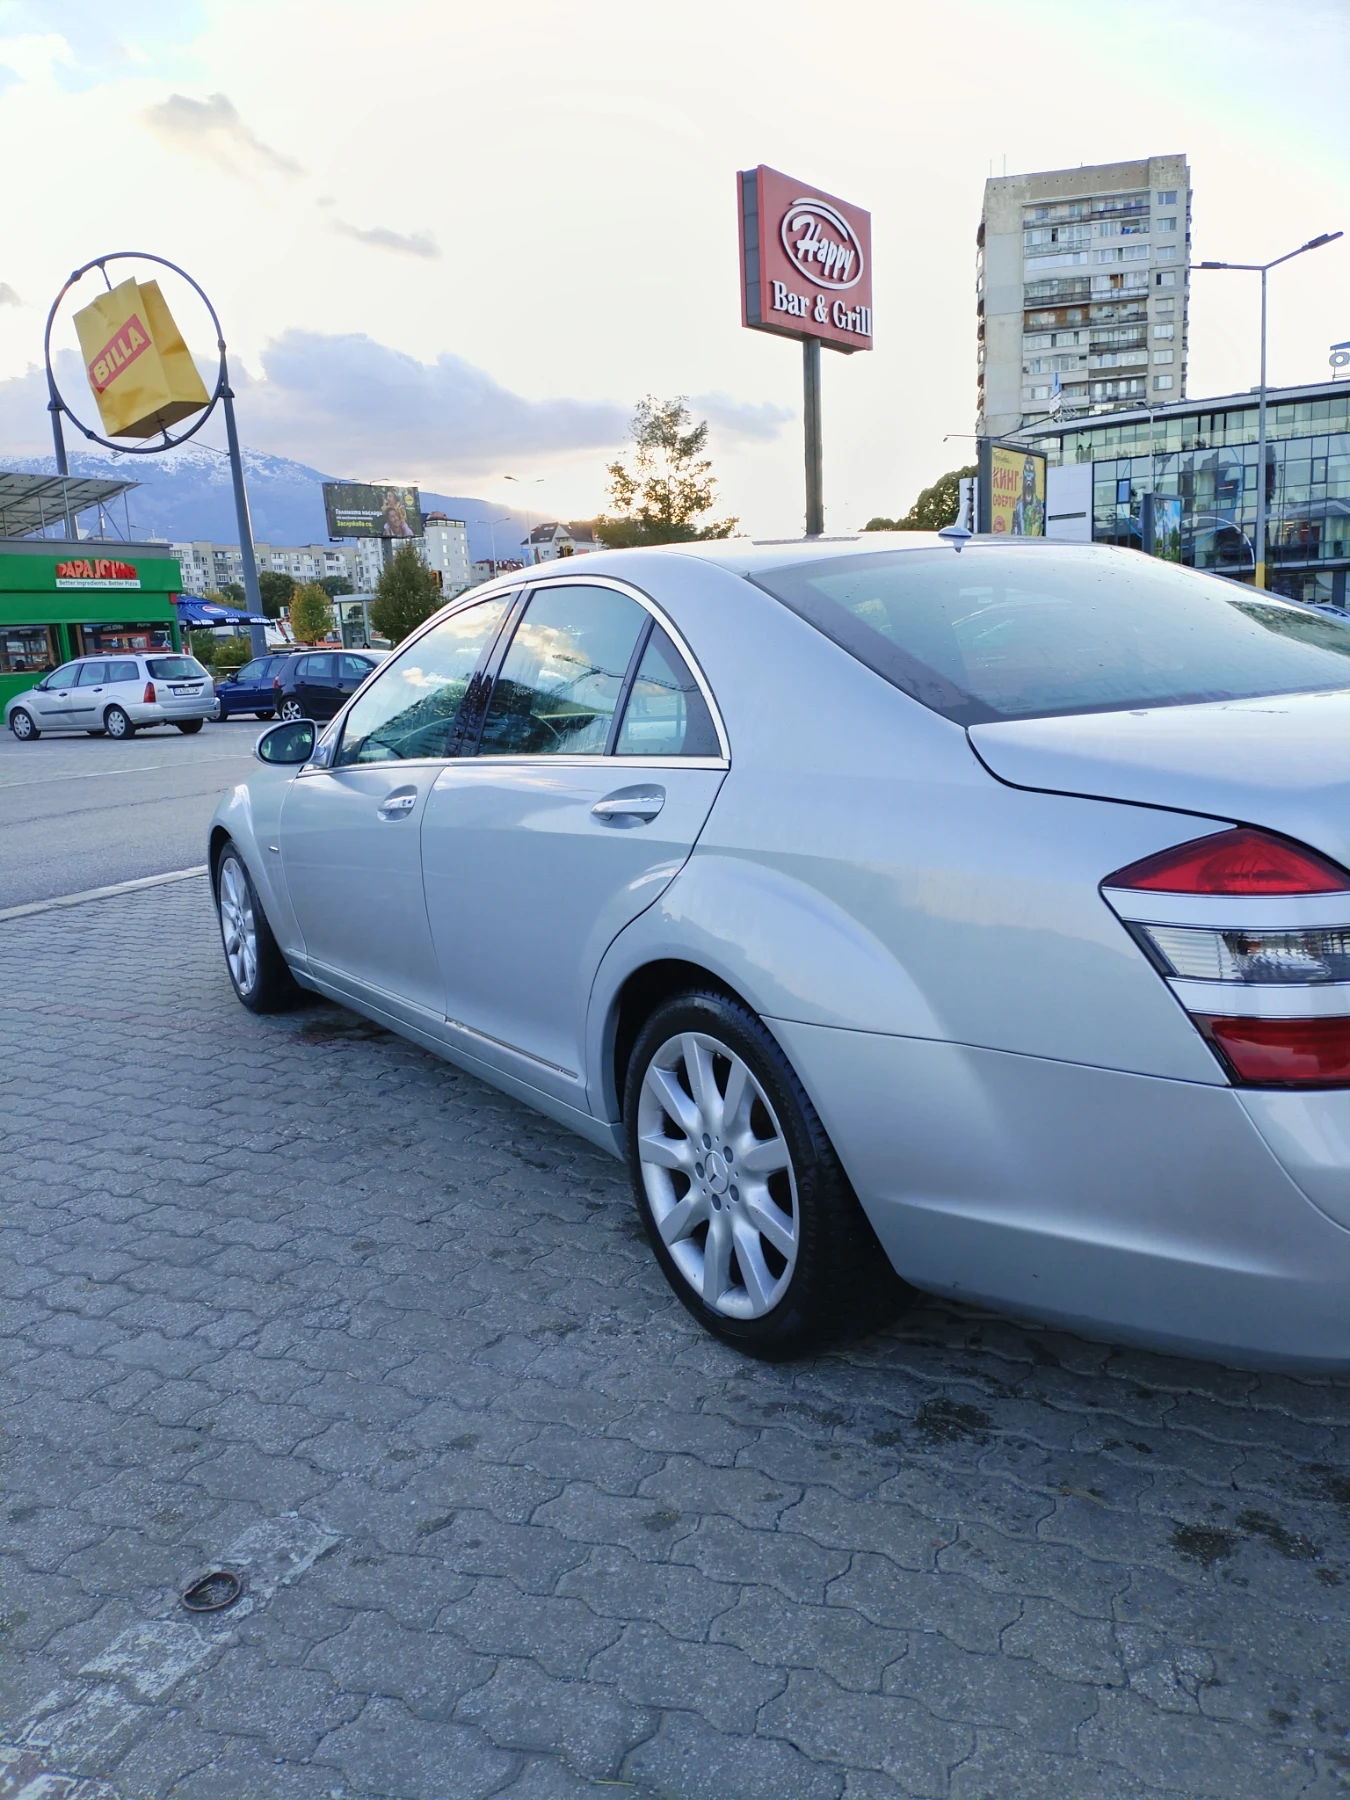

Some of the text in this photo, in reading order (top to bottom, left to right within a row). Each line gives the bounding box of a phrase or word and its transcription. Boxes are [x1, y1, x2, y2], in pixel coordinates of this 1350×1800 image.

[792, 215, 855, 281] Happy
[772, 280, 872, 337] Bar & Grill
[93, 326, 146, 385] BILLA
[993, 466, 1019, 491] КИНГ
[993, 494, 1016, 509] ОФЕРТИ
[56, 559, 94, 578] PAPA
